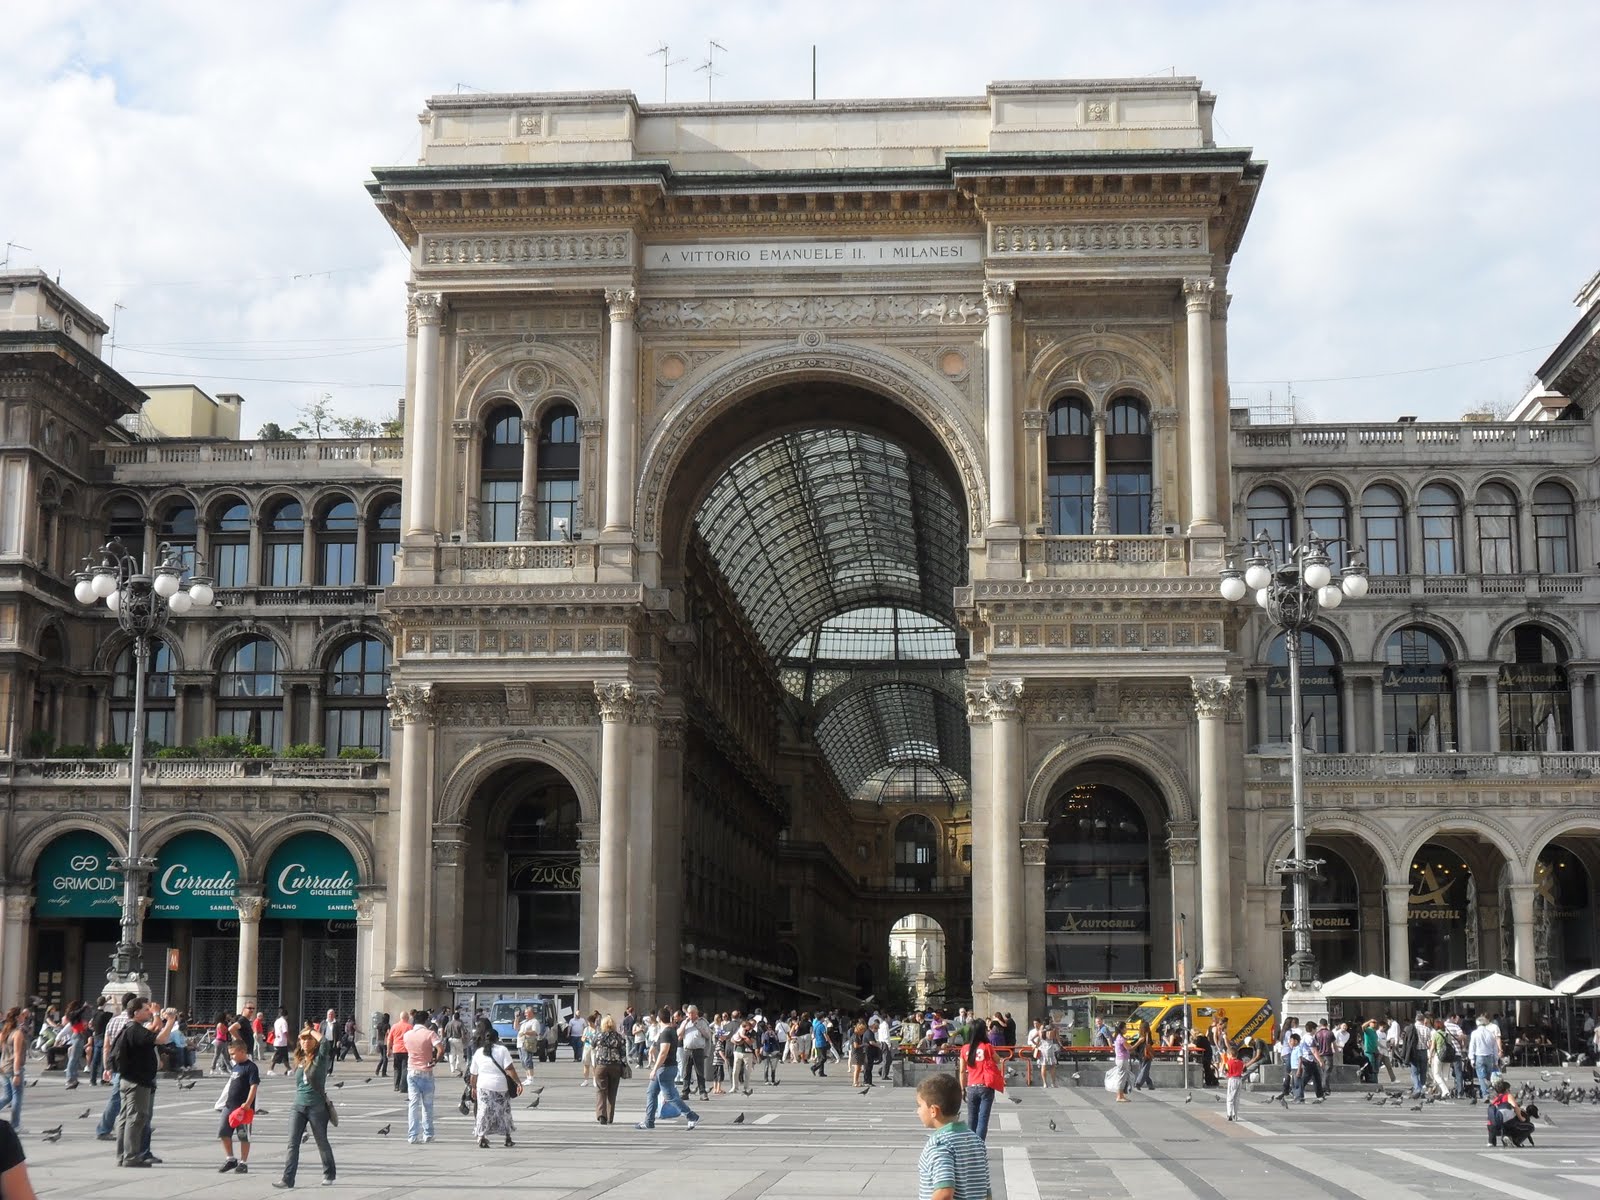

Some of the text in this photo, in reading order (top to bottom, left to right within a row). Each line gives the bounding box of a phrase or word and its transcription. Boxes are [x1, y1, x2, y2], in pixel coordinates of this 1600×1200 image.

[661, 252, 671, 262] A
[681, 251, 750, 262] VITTORIO
[760, 249, 843, 261] EMANUELE
[893, 246, 963, 258] MILANESI
[1287, 677, 1335, 685] TOGRILL
[53, 877, 116, 890] GRIMOLDI
[160, 863, 236, 896] Currado
[277, 863, 354, 895] Currado
[1407, 910, 1460, 919] UTOGRILL
[1080, 919, 1137, 928] AUTOGRILL
[1310, 917, 1351, 927] TOGRILL
[1065, 984, 1100, 994] Repubblica
[1129, 984, 1164, 995] Repubblica
